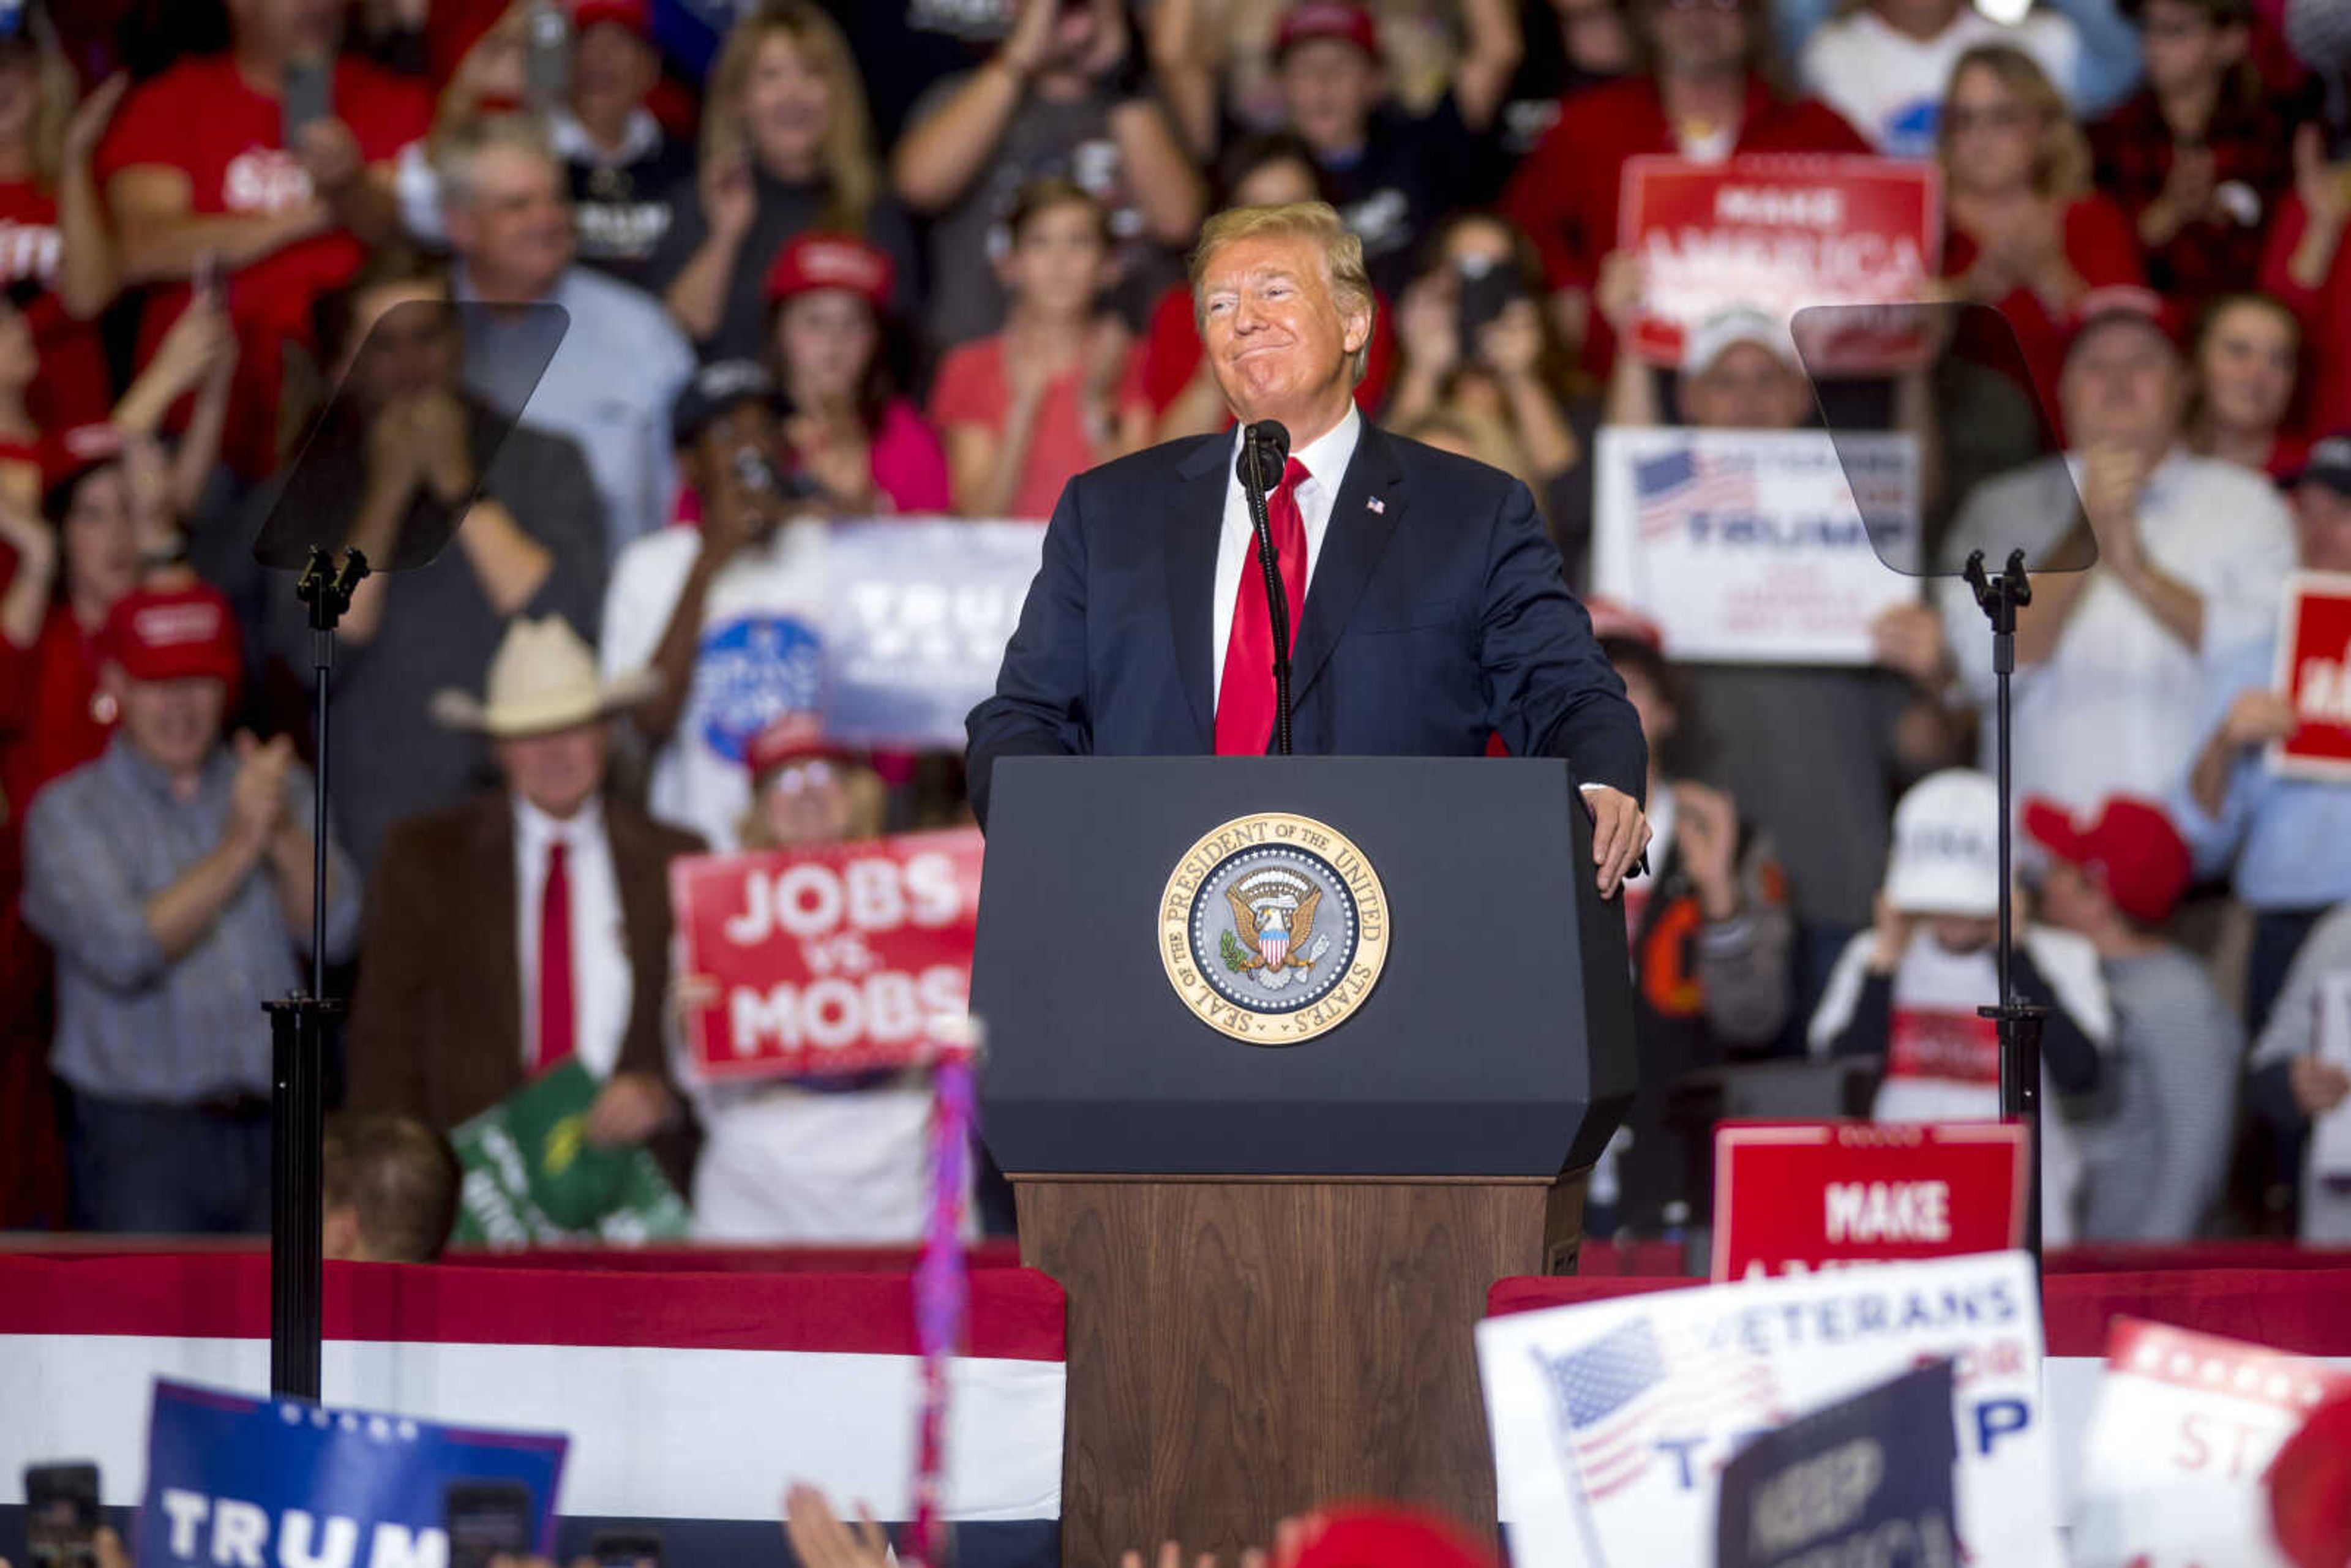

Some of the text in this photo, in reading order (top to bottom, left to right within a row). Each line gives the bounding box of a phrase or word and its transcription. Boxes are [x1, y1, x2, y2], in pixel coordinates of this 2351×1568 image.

[1688, 514, 1907, 546] TRUMP
[724, 853, 962, 947] JOBS
[1167, 822, 1382, 1033] SEAL OF THE PRESIDENT OF THE UNITED STATES
[729, 965, 972, 1057] MOBS
[1824, 1180, 1952, 1245] MAKE
